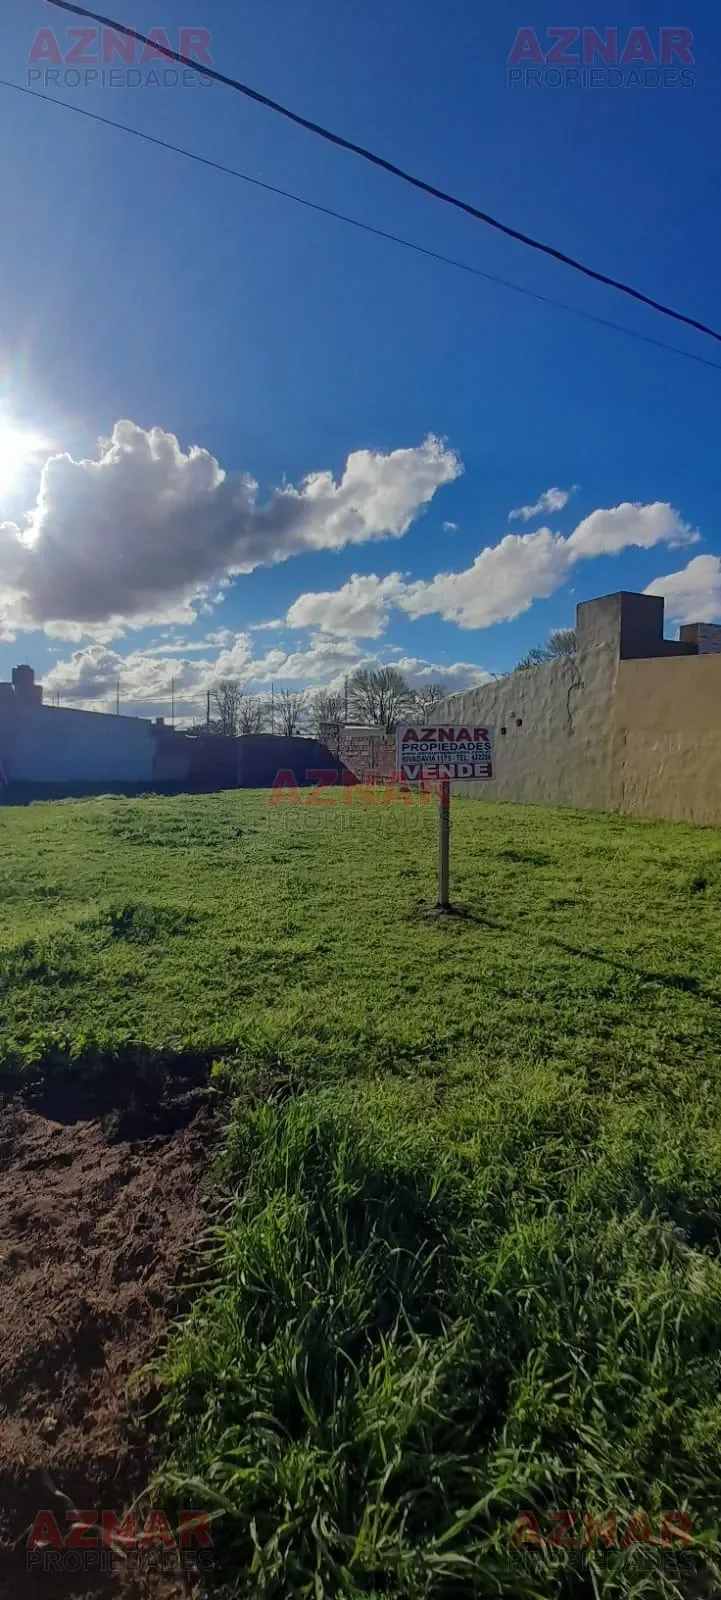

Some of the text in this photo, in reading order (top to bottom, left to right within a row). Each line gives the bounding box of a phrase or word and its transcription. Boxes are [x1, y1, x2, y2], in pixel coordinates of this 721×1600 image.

[402, 728, 490, 742] AZNAR
[402, 742, 492, 751] PROPIEDADES
[402, 764, 489, 778] VENDE
